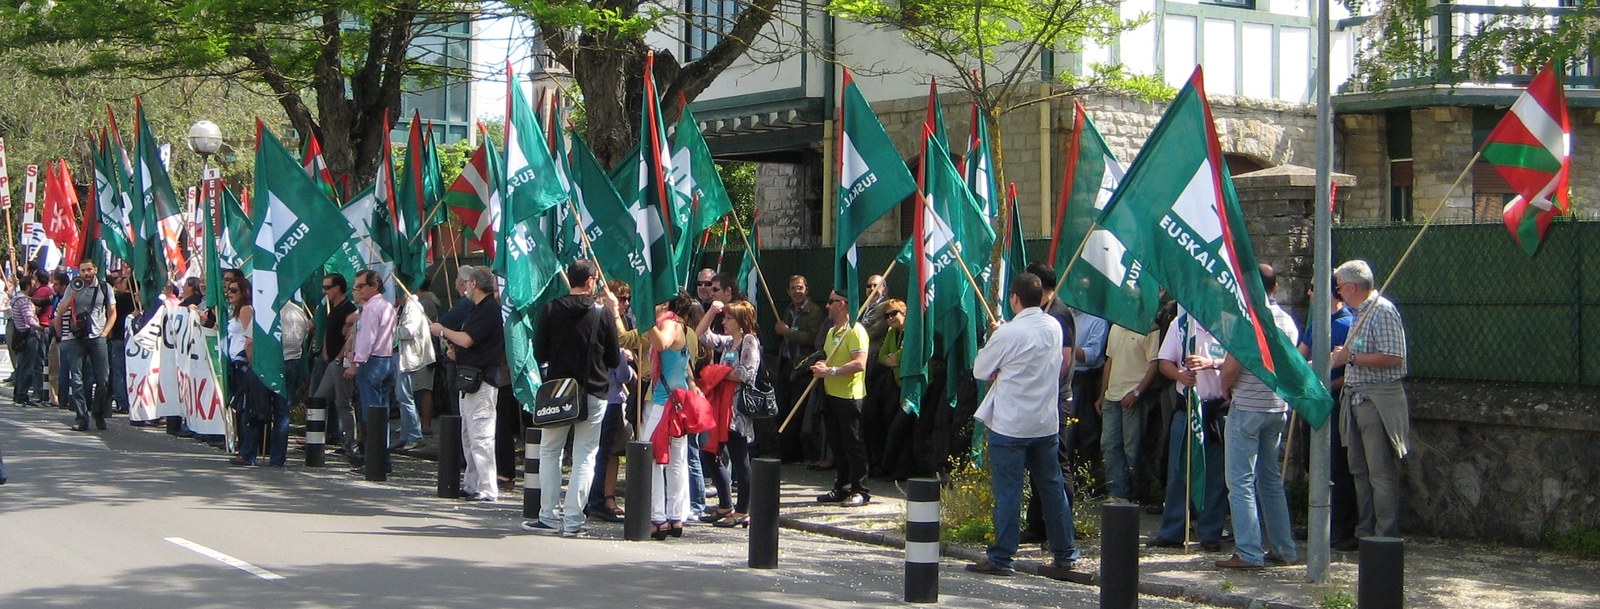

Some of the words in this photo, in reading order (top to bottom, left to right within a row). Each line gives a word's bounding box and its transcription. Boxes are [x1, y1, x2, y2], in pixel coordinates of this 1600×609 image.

[23, 165, 37, 234] SIPE
[1158, 214, 1217, 274] EUSKAL
[348, 255, 364, 273] SIN
[536, 405, 560, 417] adidas
